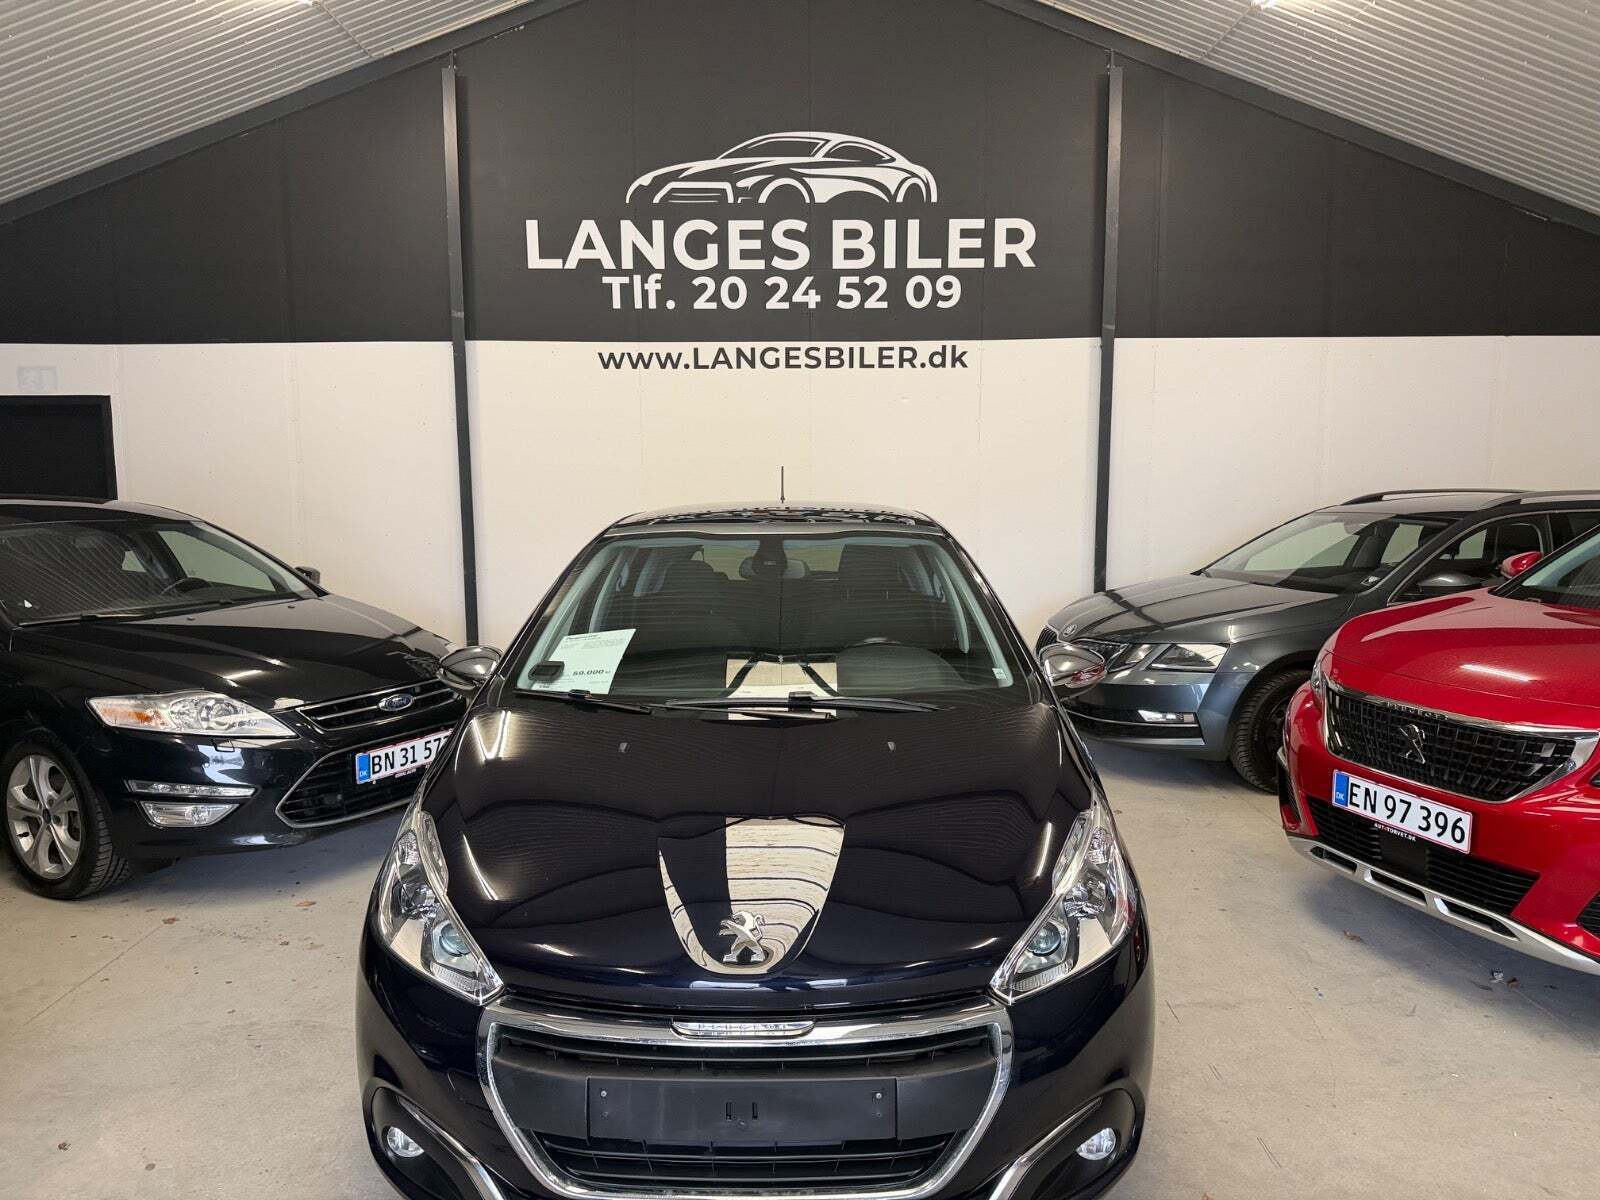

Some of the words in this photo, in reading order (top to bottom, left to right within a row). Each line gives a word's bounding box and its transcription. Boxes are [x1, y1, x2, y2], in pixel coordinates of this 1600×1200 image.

[526, 219, 810, 270] LANGES
[832, 217, 1037, 269] BILER
[602, 273, 675, 309] Tlf.
[692, 276, 748, 309] 20
[765, 276, 821, 309] 24
[836, 276, 888, 309] 52
[905, 275, 962, 308] 09
[598, 345, 968, 370] www.LANGESBILER.dk
[371, 750, 395, 775] BN
[400, 744, 417, 767] 31
[1335, 791, 1345, 801] DK
[1349, 782, 1377, 814] EN
[1384, 794, 1412, 824] 97
[1417, 805, 1465, 844] 396
